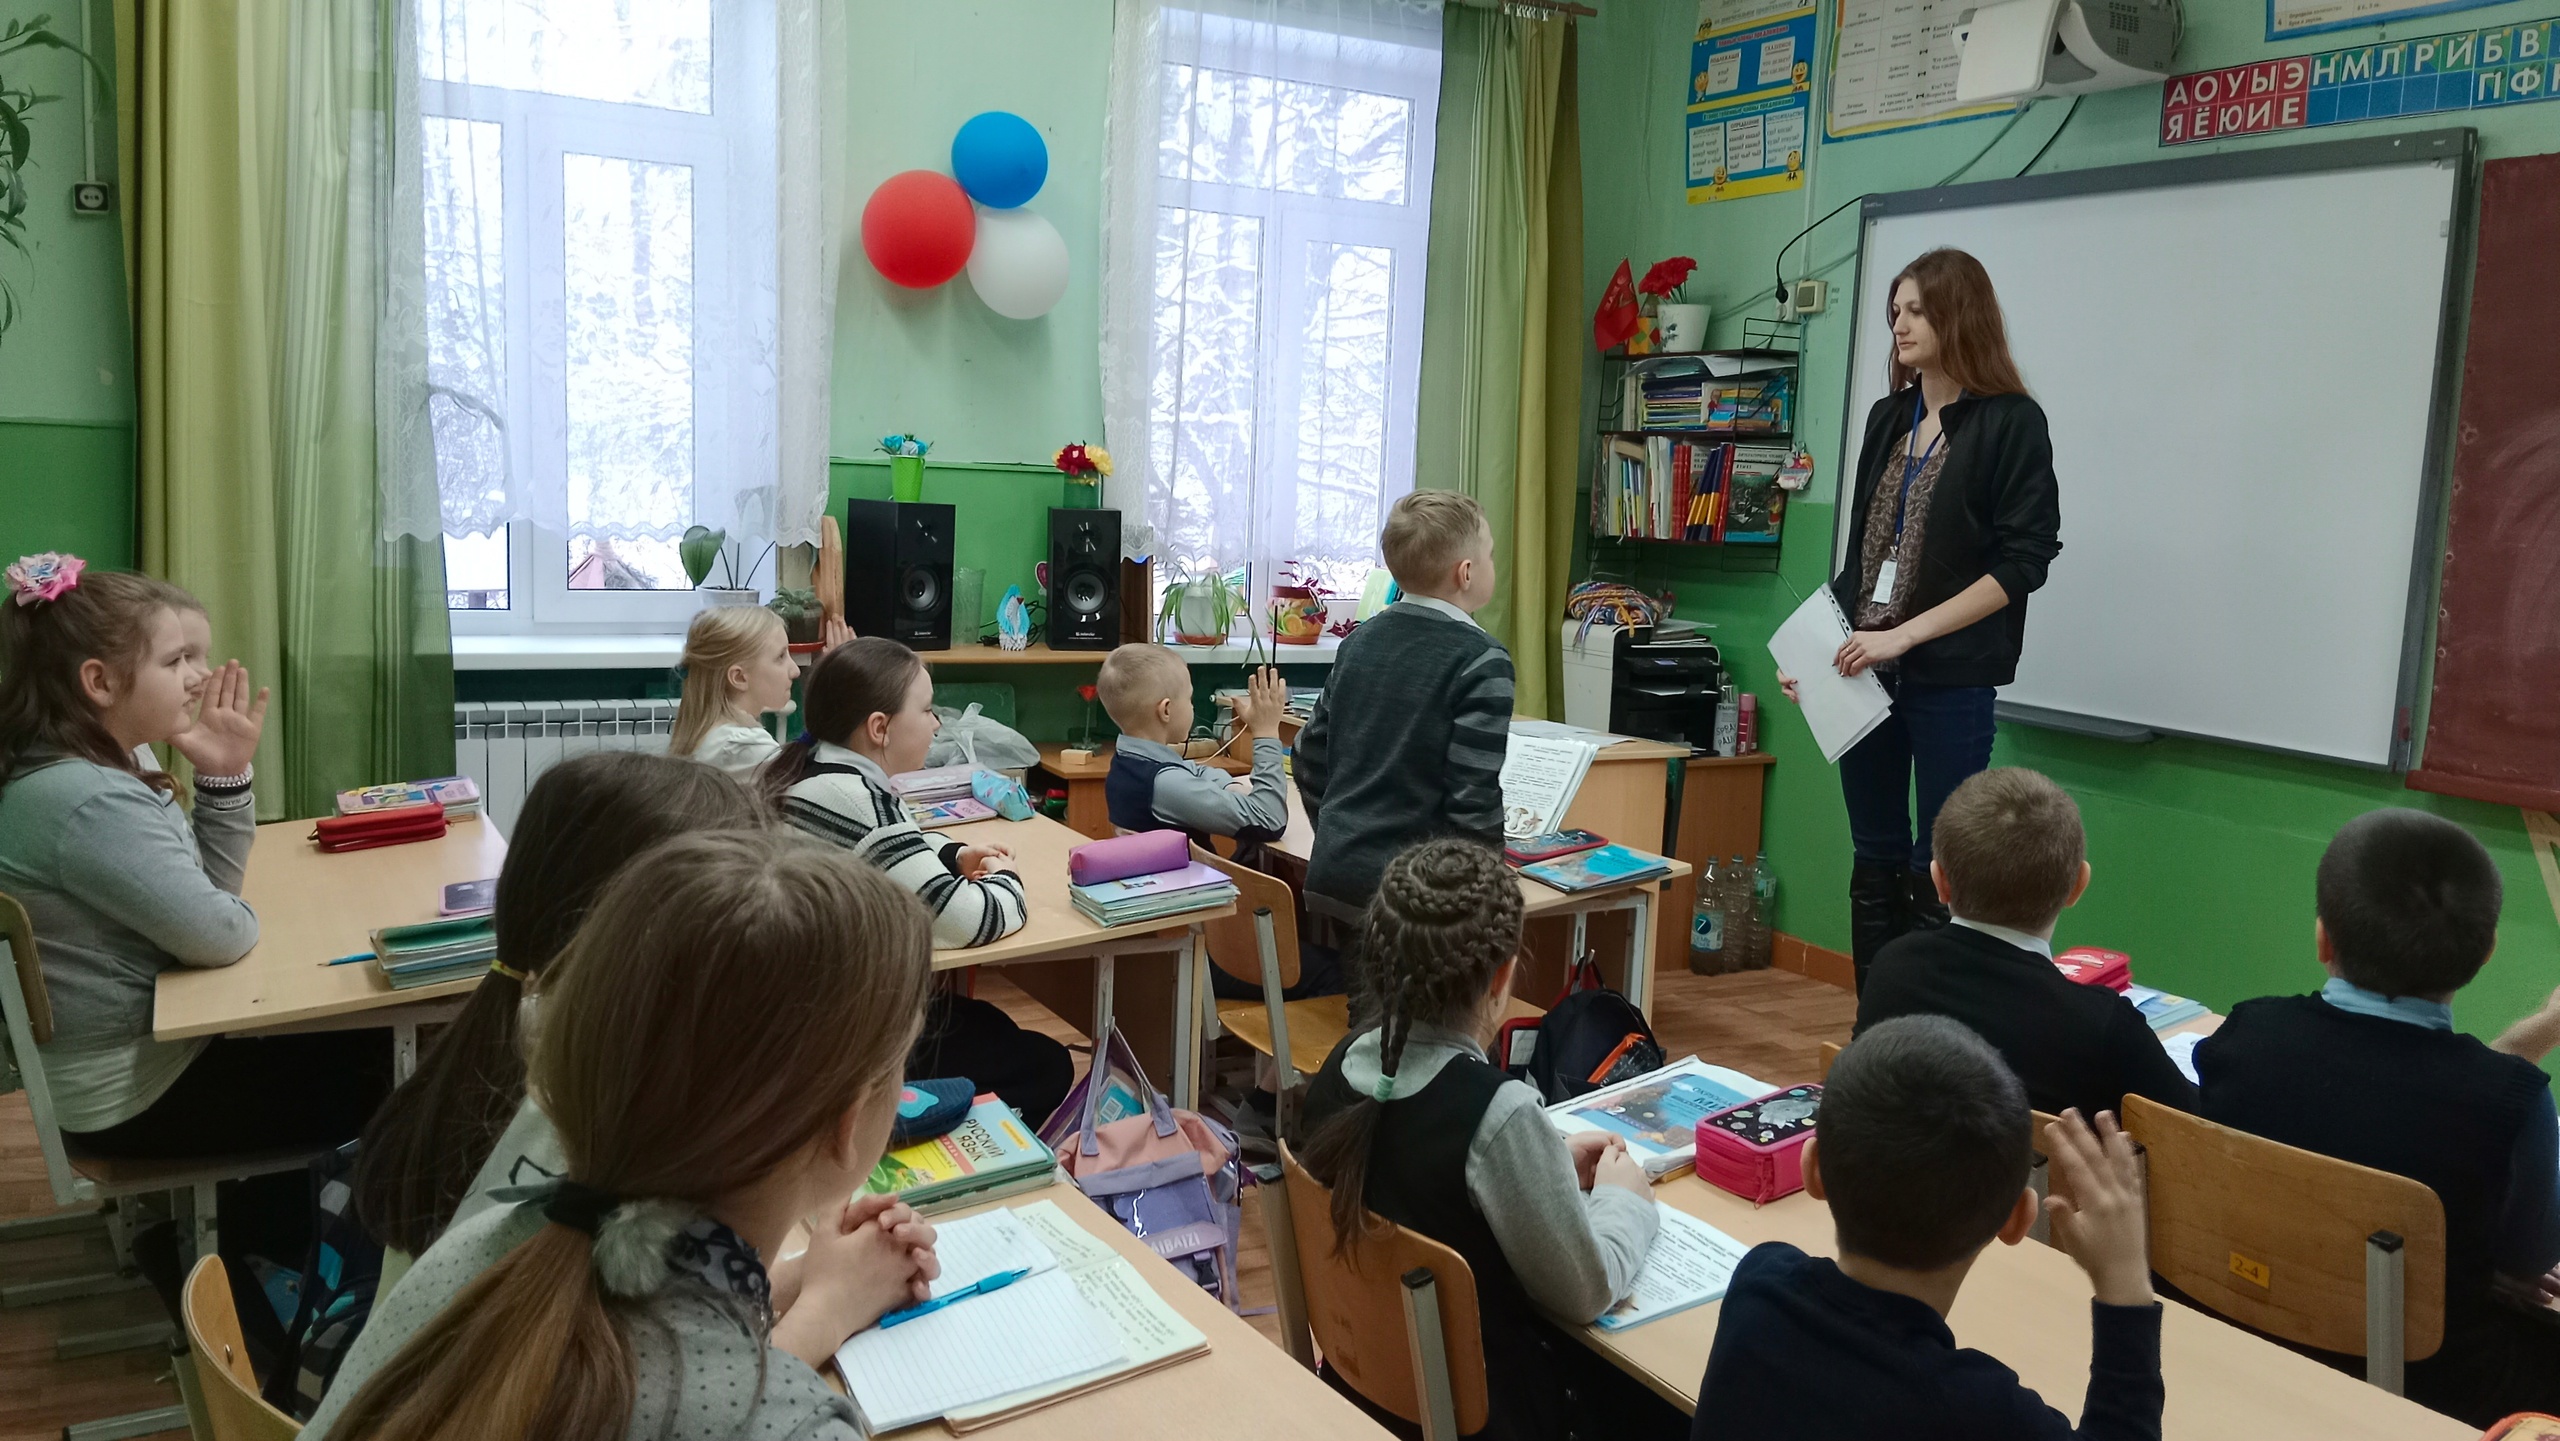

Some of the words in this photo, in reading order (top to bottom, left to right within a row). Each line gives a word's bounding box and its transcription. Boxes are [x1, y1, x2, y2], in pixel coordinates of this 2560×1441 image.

[957, 1135, 988, 1162] ЯЗЫК
[966, 1118, 1008, 1158] РУССКИЙ
[2234, 1257, 2258, 1279] 2-4
